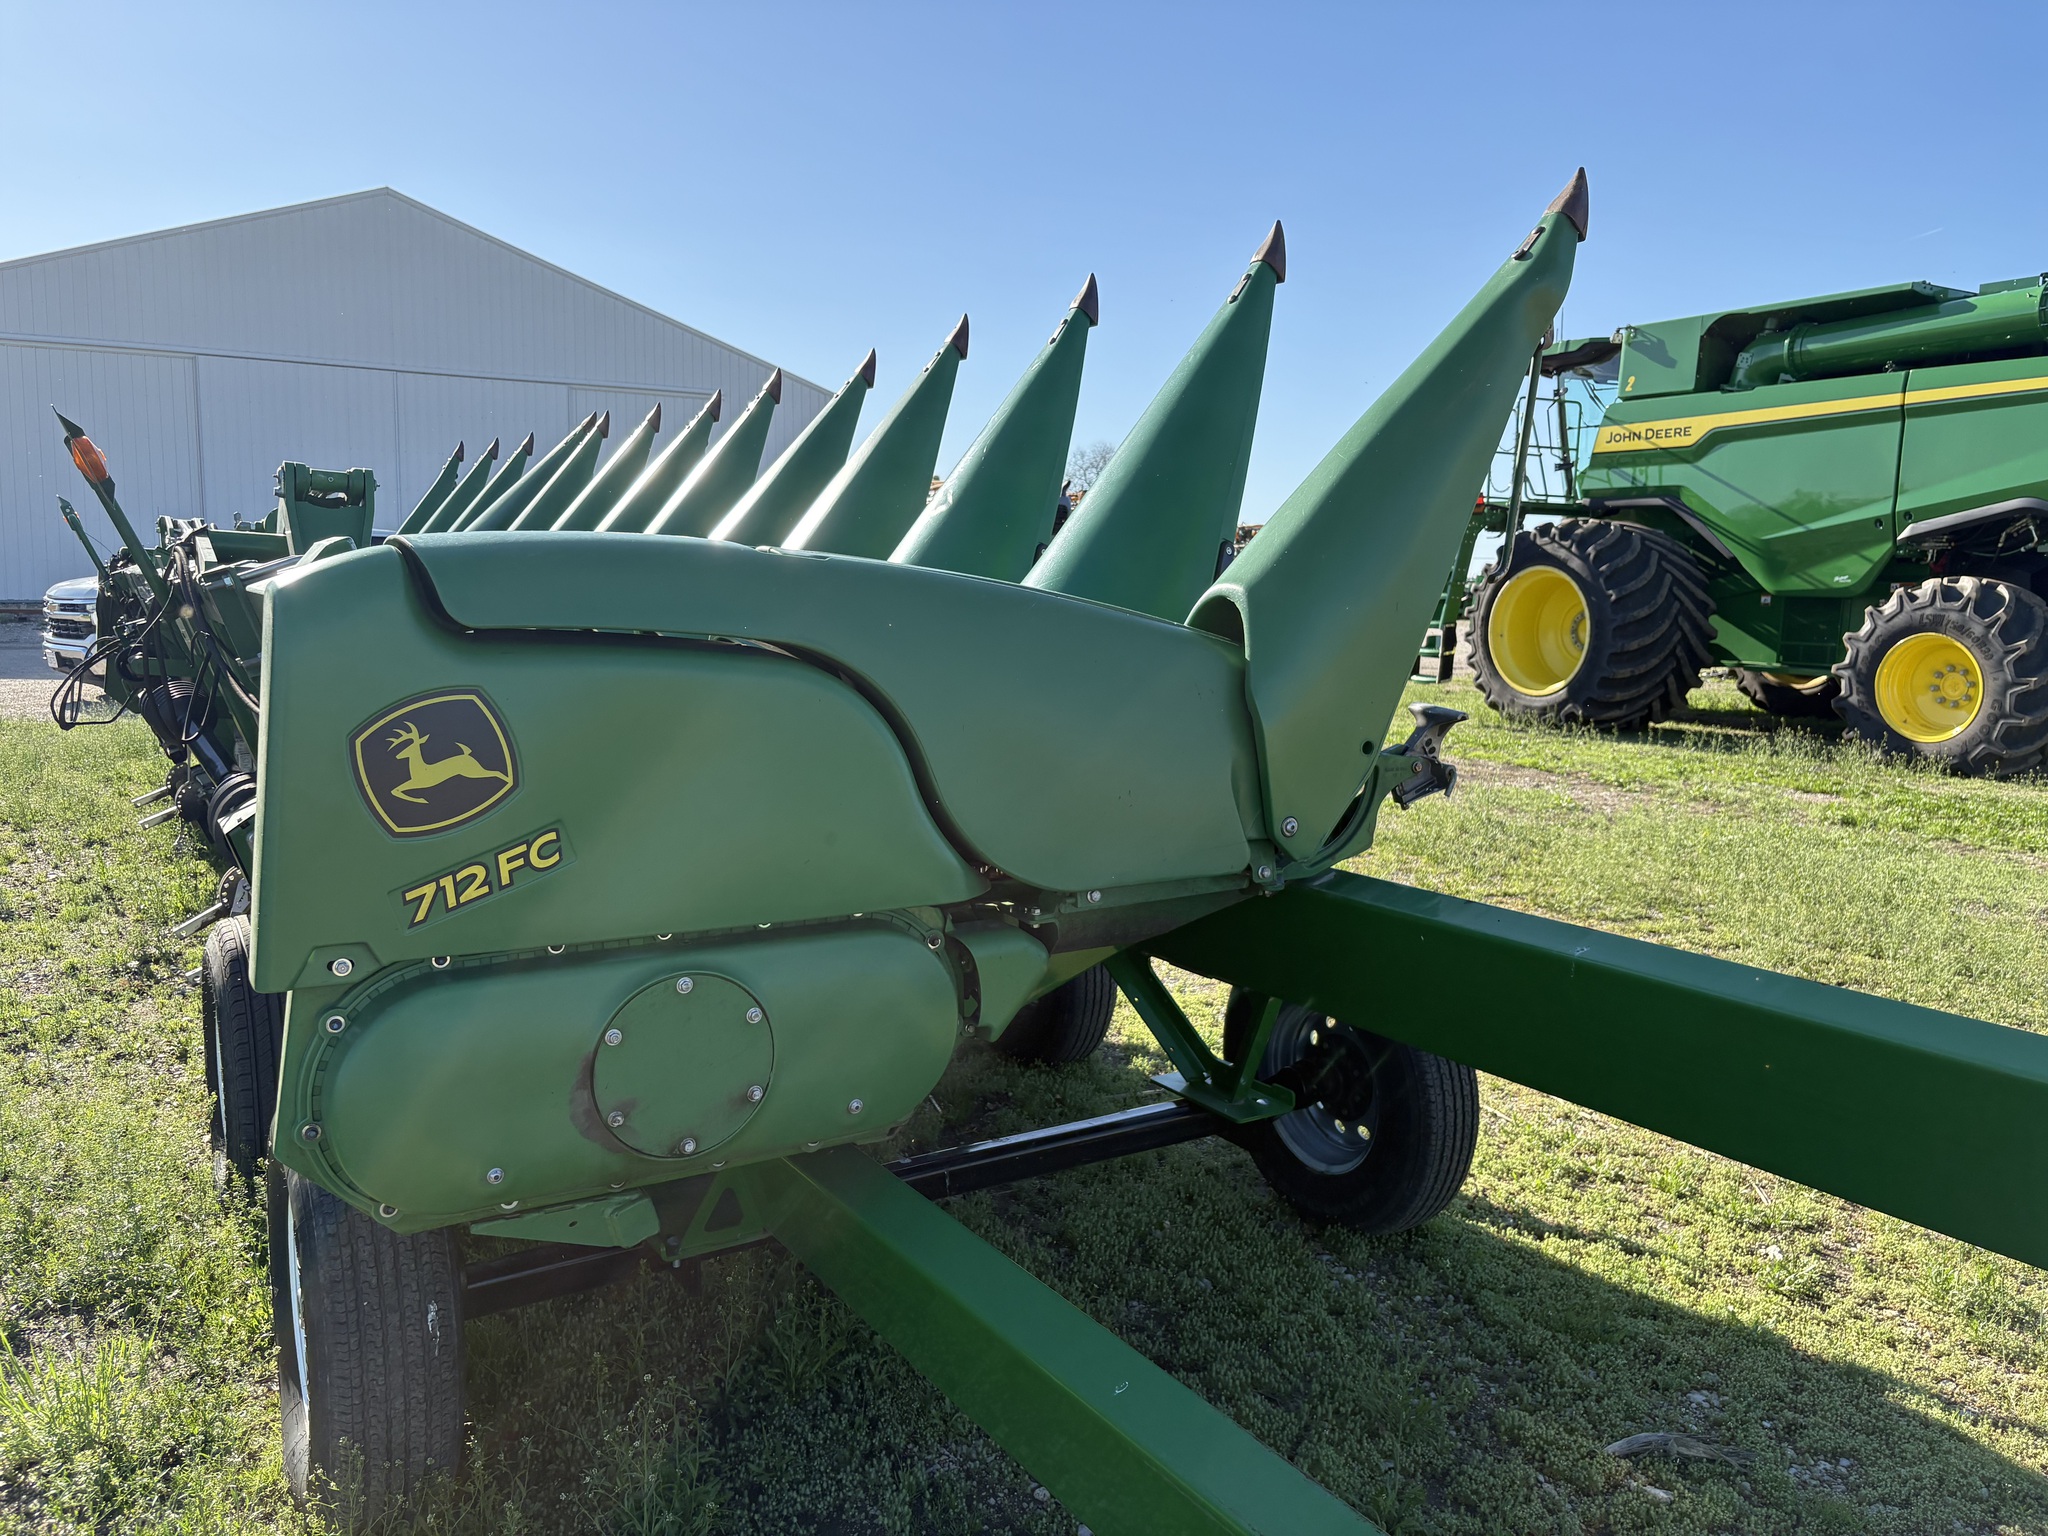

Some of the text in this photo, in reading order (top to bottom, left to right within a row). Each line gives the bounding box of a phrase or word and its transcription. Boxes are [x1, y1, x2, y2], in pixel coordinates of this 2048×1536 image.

[1625, 375, 1636, 391] 2
[1605, 426, 1692, 444] JOHN DEERE
[402, 828, 563, 929] 712 FC
